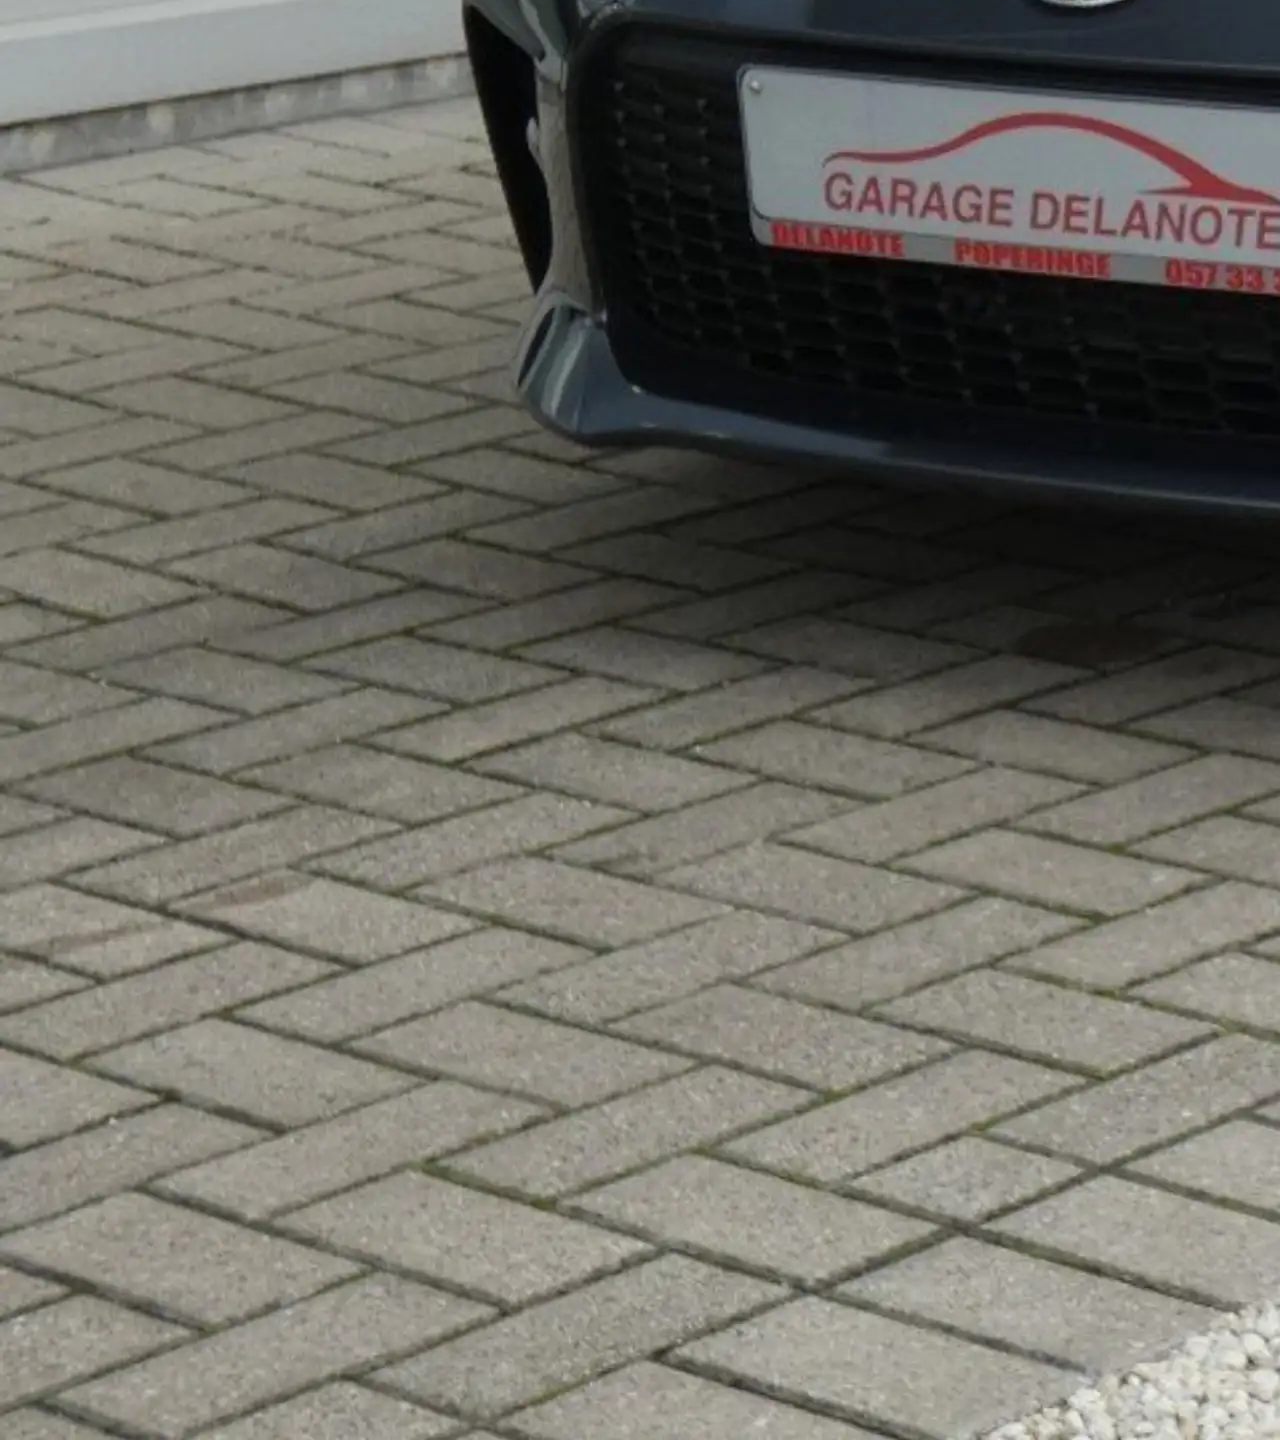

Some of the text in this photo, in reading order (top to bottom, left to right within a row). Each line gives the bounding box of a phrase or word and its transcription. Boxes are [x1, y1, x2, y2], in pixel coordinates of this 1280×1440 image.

[824, 171, 1014, 227] GARAGE
[770, 221, 905, 258] DELANOTE
[954, 237, 1112, 280] POPERINGE
[1164, 257, 1218, 288] 057
